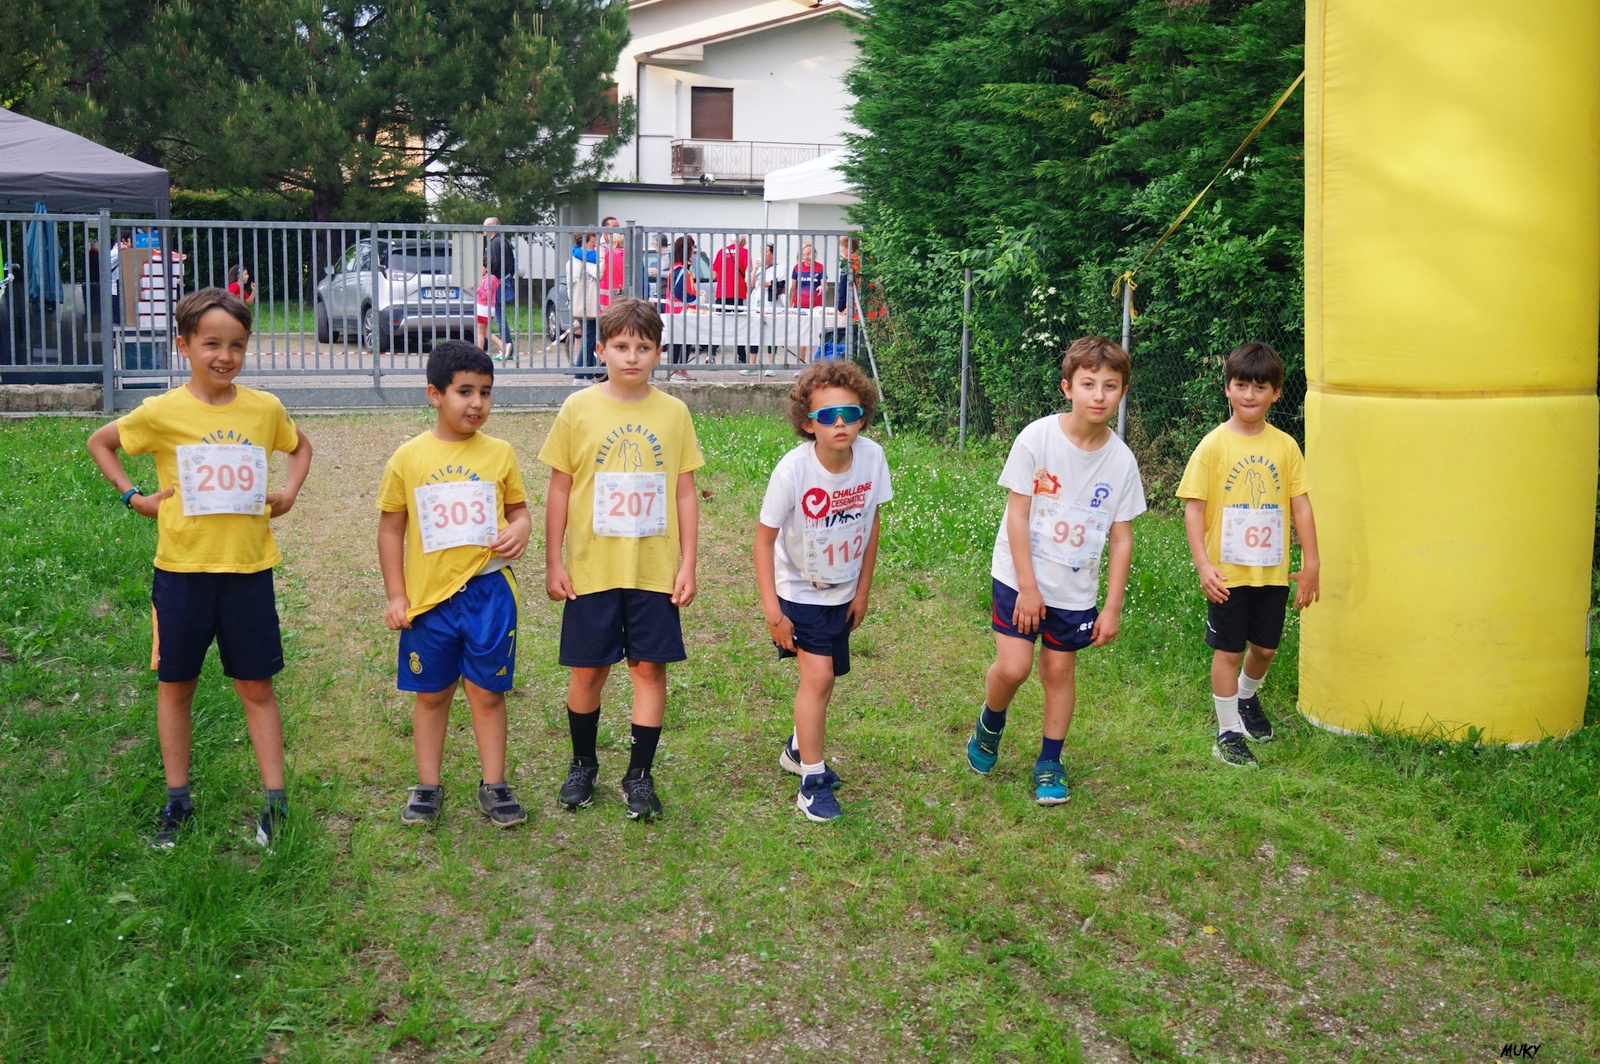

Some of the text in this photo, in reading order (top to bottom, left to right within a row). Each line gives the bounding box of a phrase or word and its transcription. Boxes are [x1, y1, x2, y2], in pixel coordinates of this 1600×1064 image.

[196, 464, 254, 492] 209
[432, 500, 487, 529] 303
[609, 491, 656, 517] 207
[1052, 520, 1086, 548] 93
[1244, 526, 1272, 549] 62
[822, 534, 864, 567] 112
